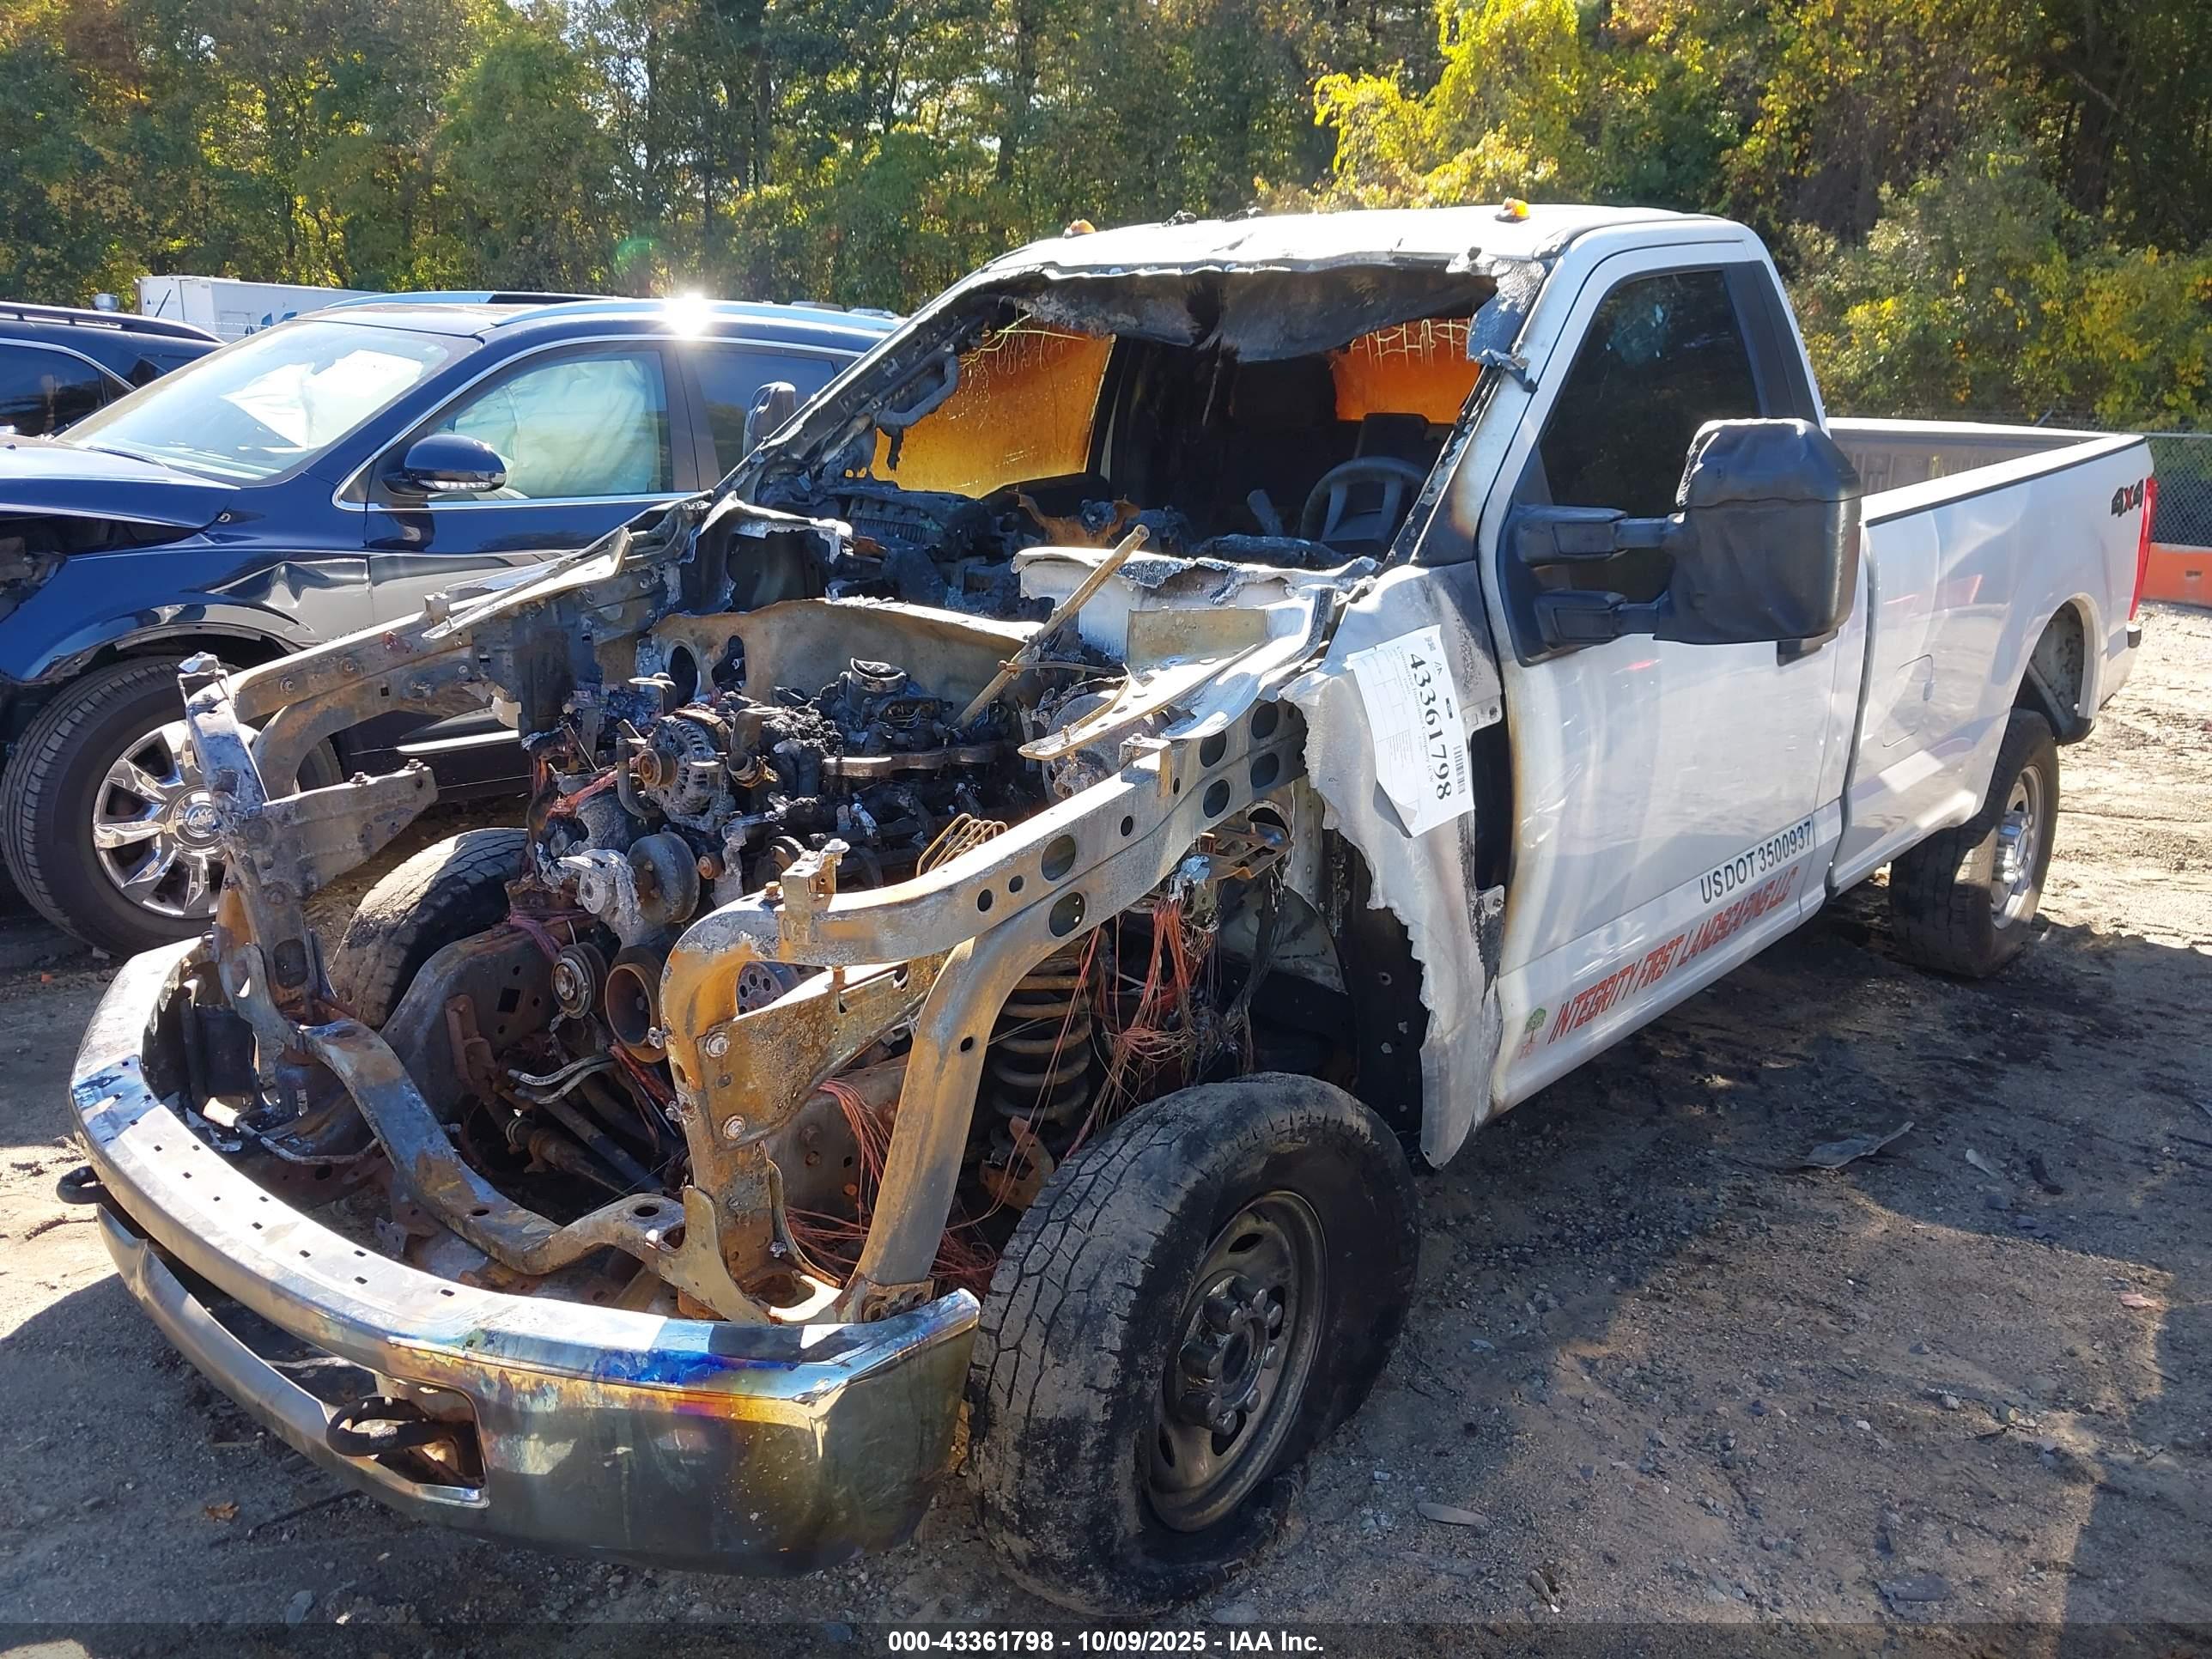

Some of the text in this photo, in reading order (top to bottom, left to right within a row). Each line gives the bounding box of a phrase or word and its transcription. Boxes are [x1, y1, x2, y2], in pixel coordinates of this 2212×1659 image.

[1410, 653, 1452, 800] 43361798
[1547, 957, 1643, 1045] INTEGRITY
[1632, 933, 1685, 994] FIRST
[1765, 865, 1799, 912] LLC
